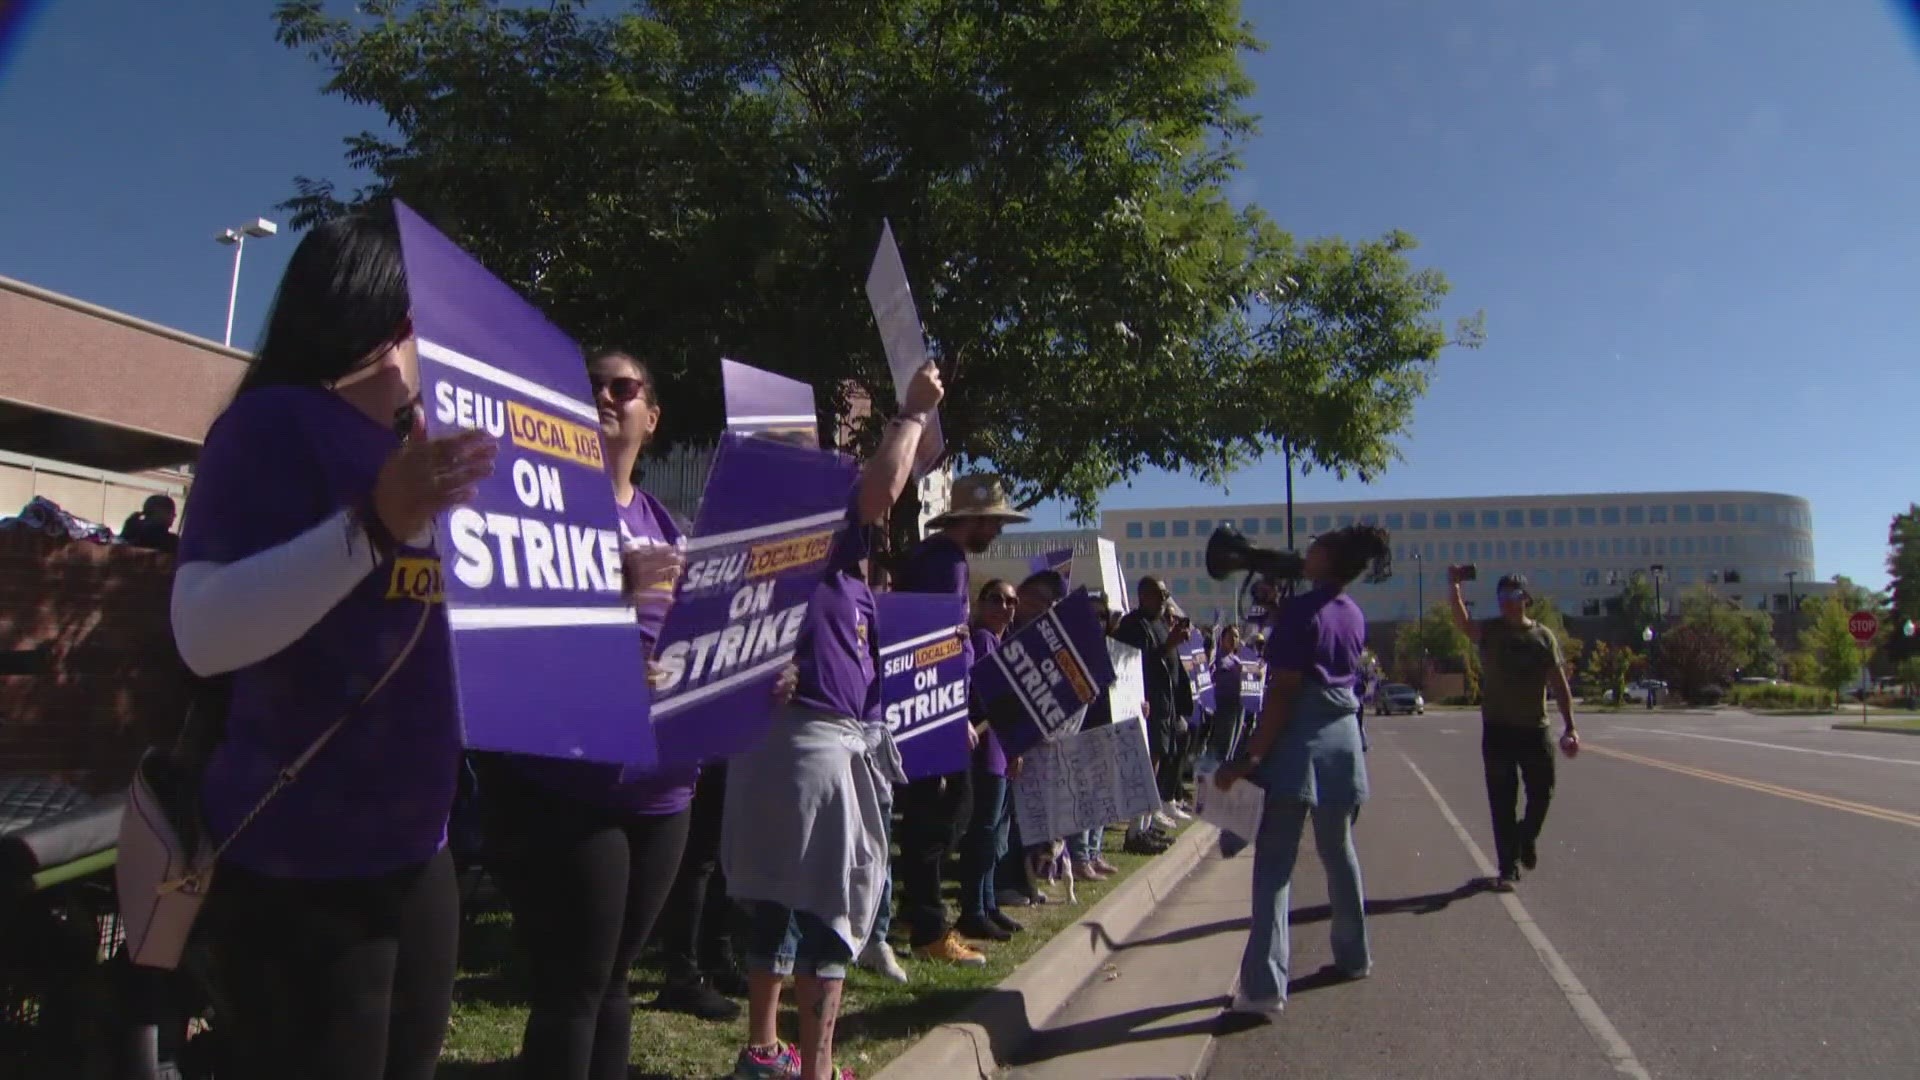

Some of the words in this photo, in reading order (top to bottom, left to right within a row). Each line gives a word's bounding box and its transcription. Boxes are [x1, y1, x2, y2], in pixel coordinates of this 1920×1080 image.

[435, 380, 504, 437] SEIU
[510, 410, 570, 451] LOCAL
[573, 430, 600, 461] 105
[512, 458, 564, 512] ON
[450, 507, 622, 591] STRIKE
[682, 551, 748, 592] SEIU
[745, 543, 801, 574] LOCAL
[729, 579, 776, 620] ON
[655, 601, 808, 690] STRIKE
[1036, 618, 1063, 653] SEIU
[1851, 620, 1875, 633] STOP
[884, 652, 914, 678] SEIU
[916, 646, 945, 666] LOCAL
[914, 667, 938, 691] ON
[1003, 640, 1066, 729] STRIKE
[1040, 658, 1062, 687] ON
[885, 679, 966, 733] STRIKE
